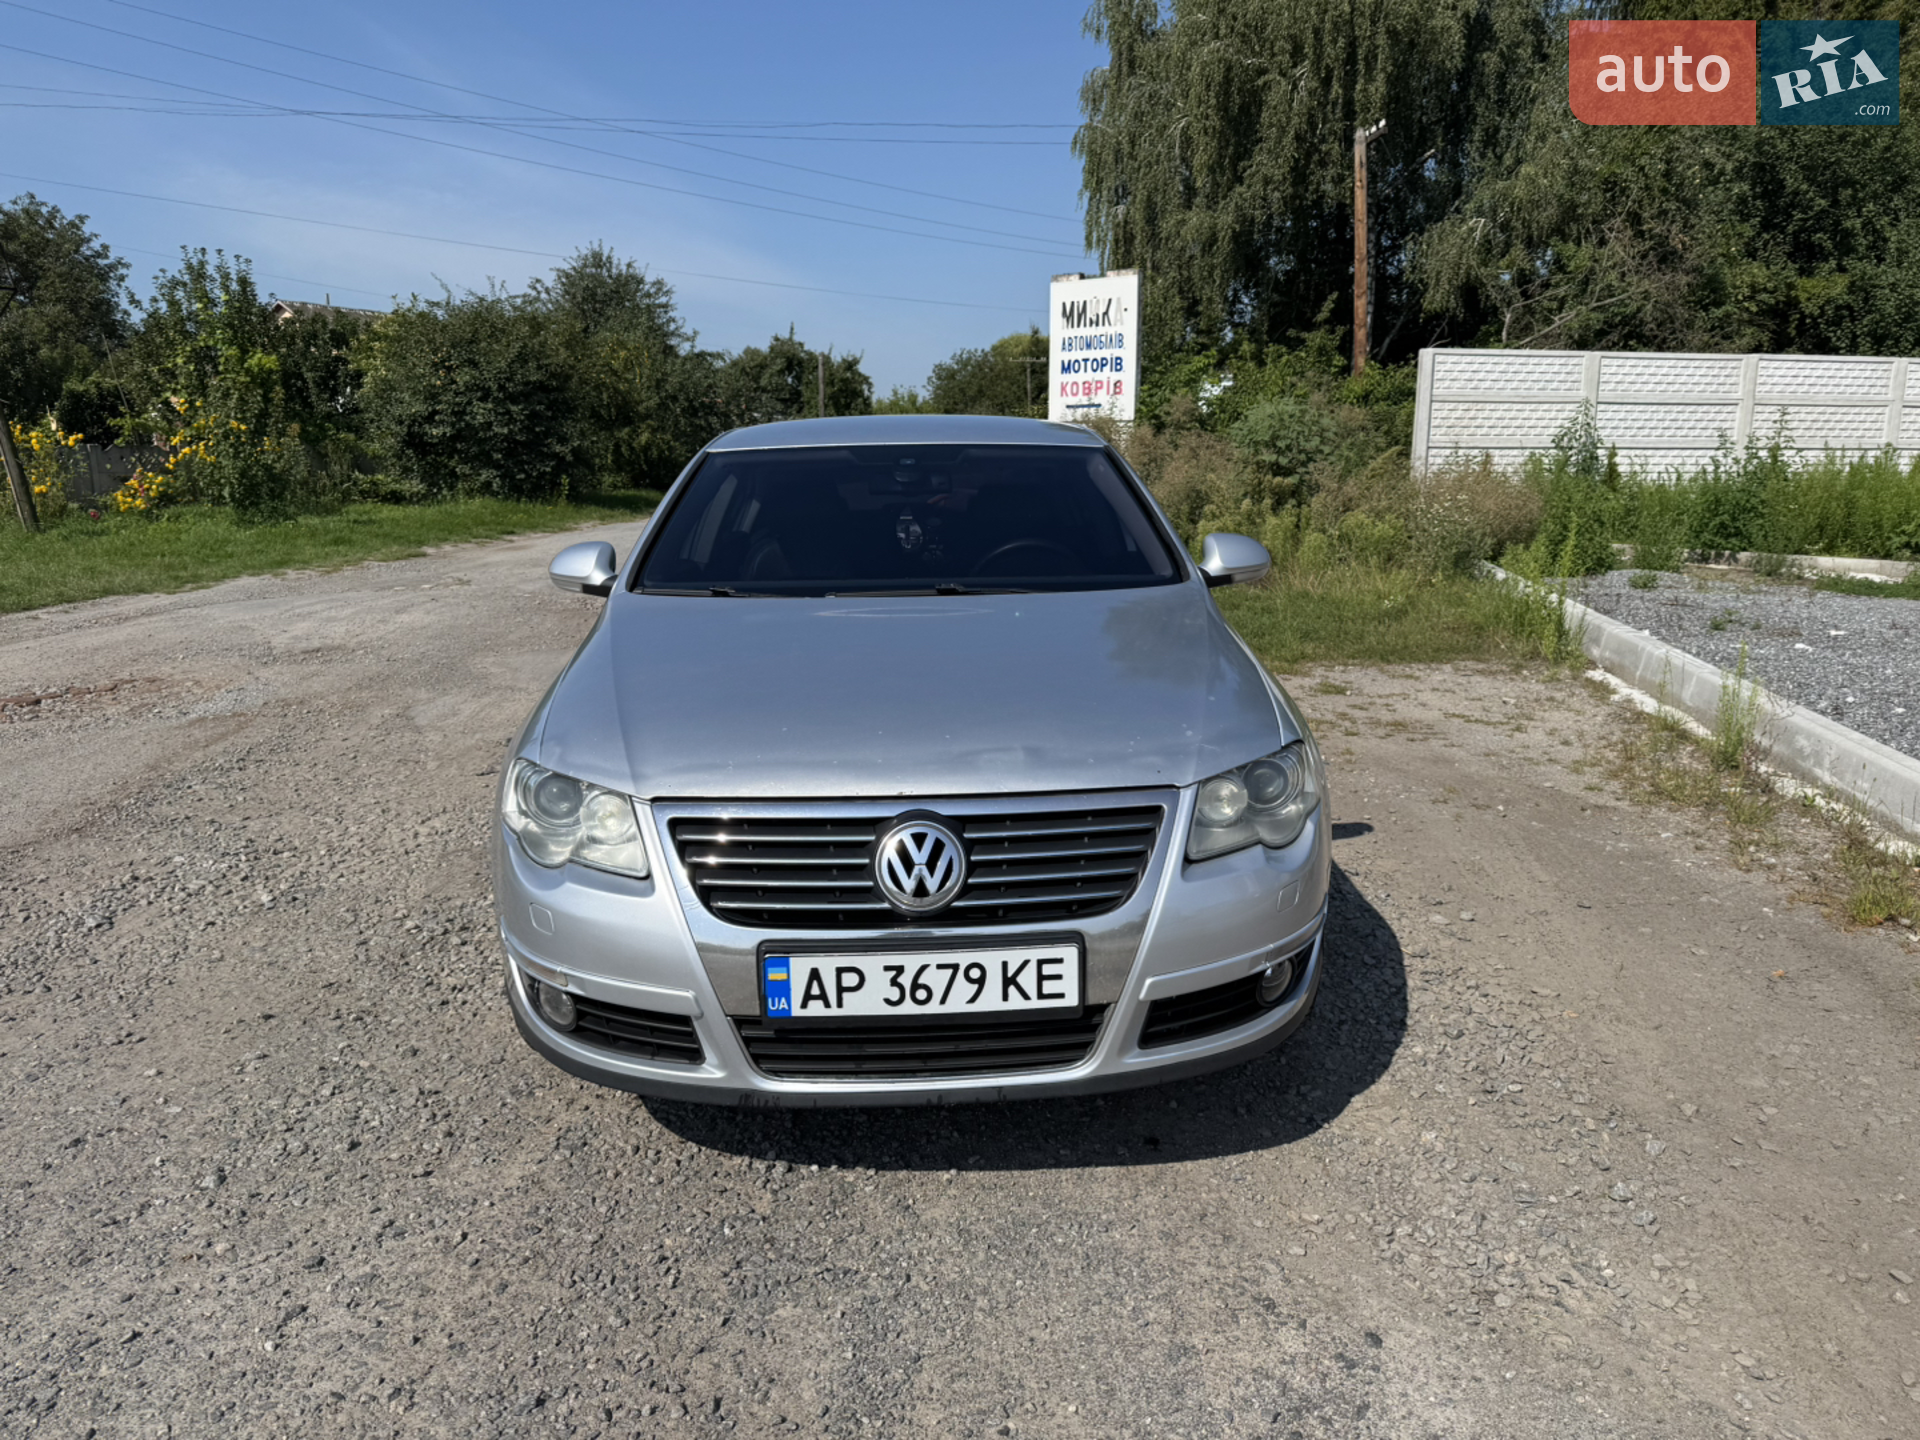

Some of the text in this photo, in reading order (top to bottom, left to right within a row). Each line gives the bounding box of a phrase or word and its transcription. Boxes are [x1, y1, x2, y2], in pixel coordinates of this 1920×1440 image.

[1061, 354, 1124, 374] МОТОРІВ
[1060, 378, 1124, 398] КОВРІВ
[800, 958, 1066, 1009] AP 3679 KE
[768, 997, 789, 1011] UA
